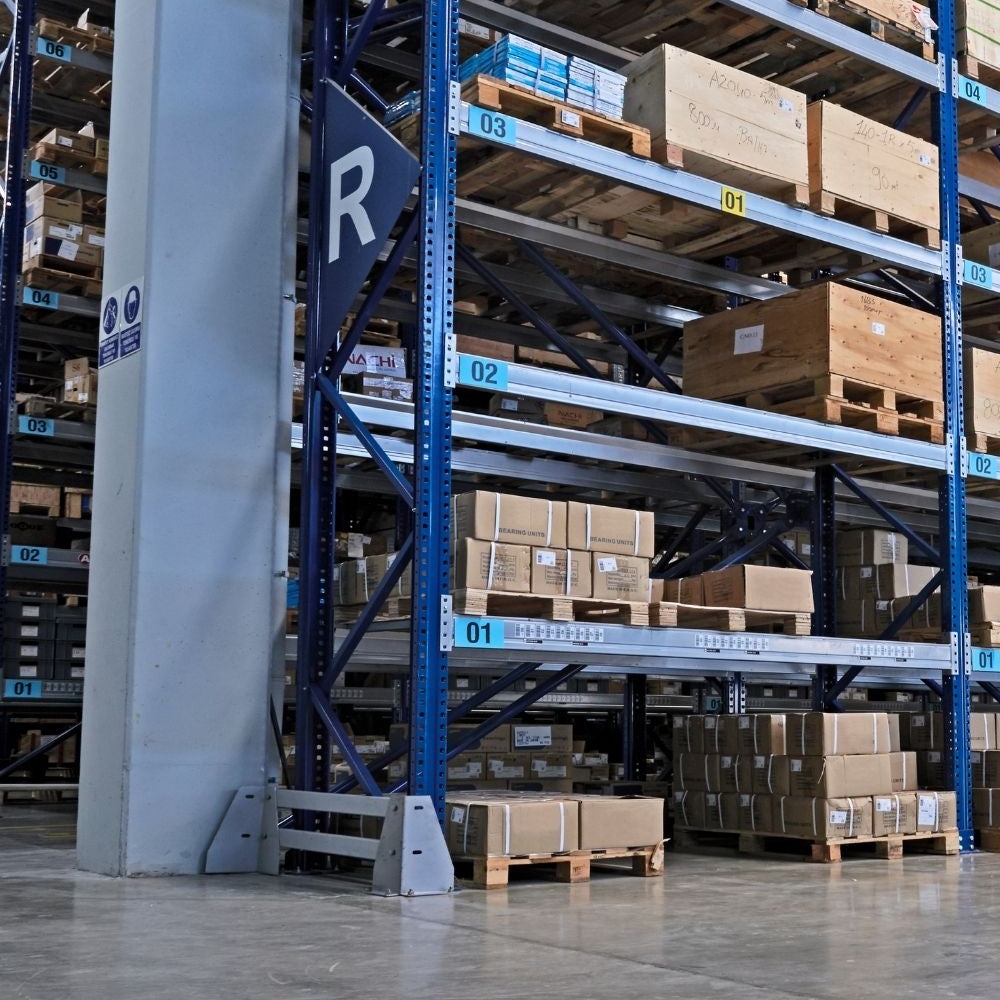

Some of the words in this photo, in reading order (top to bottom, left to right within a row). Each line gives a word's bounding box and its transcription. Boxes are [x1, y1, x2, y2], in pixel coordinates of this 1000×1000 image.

[46, 42, 65, 58] 06
[965, 83, 980, 102] 04
[481, 113, 506, 138] 03
[40, 164, 58, 180] 05
[328, 146, 376, 264] R
[725, 190, 743, 212] 01
[971, 266, 987, 283] 03
[32, 290, 50, 305] 04
[472, 361, 497, 384] 02
[28, 418, 47, 433] 03
[976, 455, 991, 473] 02
[499, 527, 526, 537] BEARING
[527, 531, 545, 539] UNITS
[590, 536, 616, 546] BEARING
[617, 539, 634, 547] UNITS
[21, 548, 39, 561] 02
[467, 622, 490, 643] 01
[979, 652, 992, 668] 01
[15, 682, 32, 695] 01
